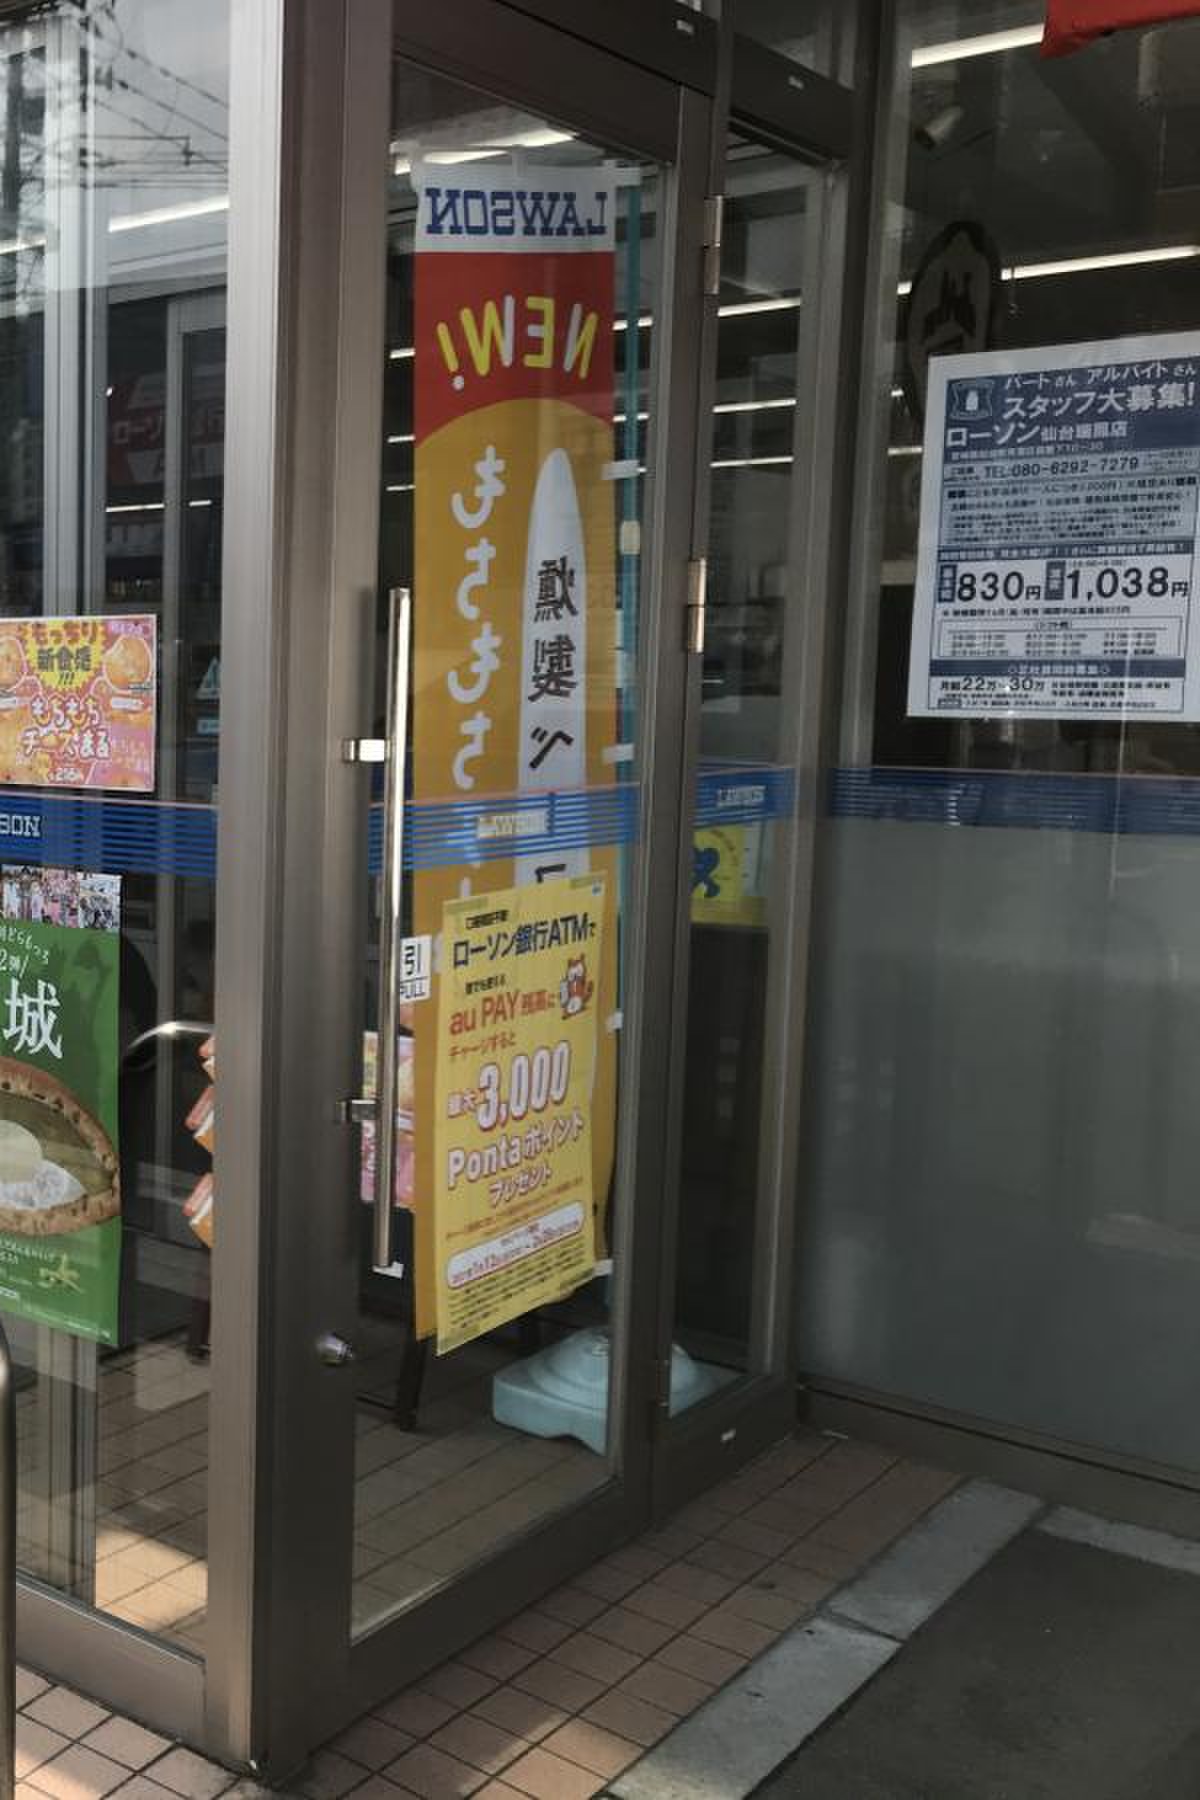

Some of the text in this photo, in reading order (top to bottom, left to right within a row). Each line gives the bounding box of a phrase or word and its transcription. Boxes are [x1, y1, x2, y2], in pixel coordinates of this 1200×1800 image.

[404, 942, 422, 976] 引
[450, 1007, 476, 1036] au
[482, 988, 521, 1028] PAY
[477, 1039, 572, 1132] 3,000
